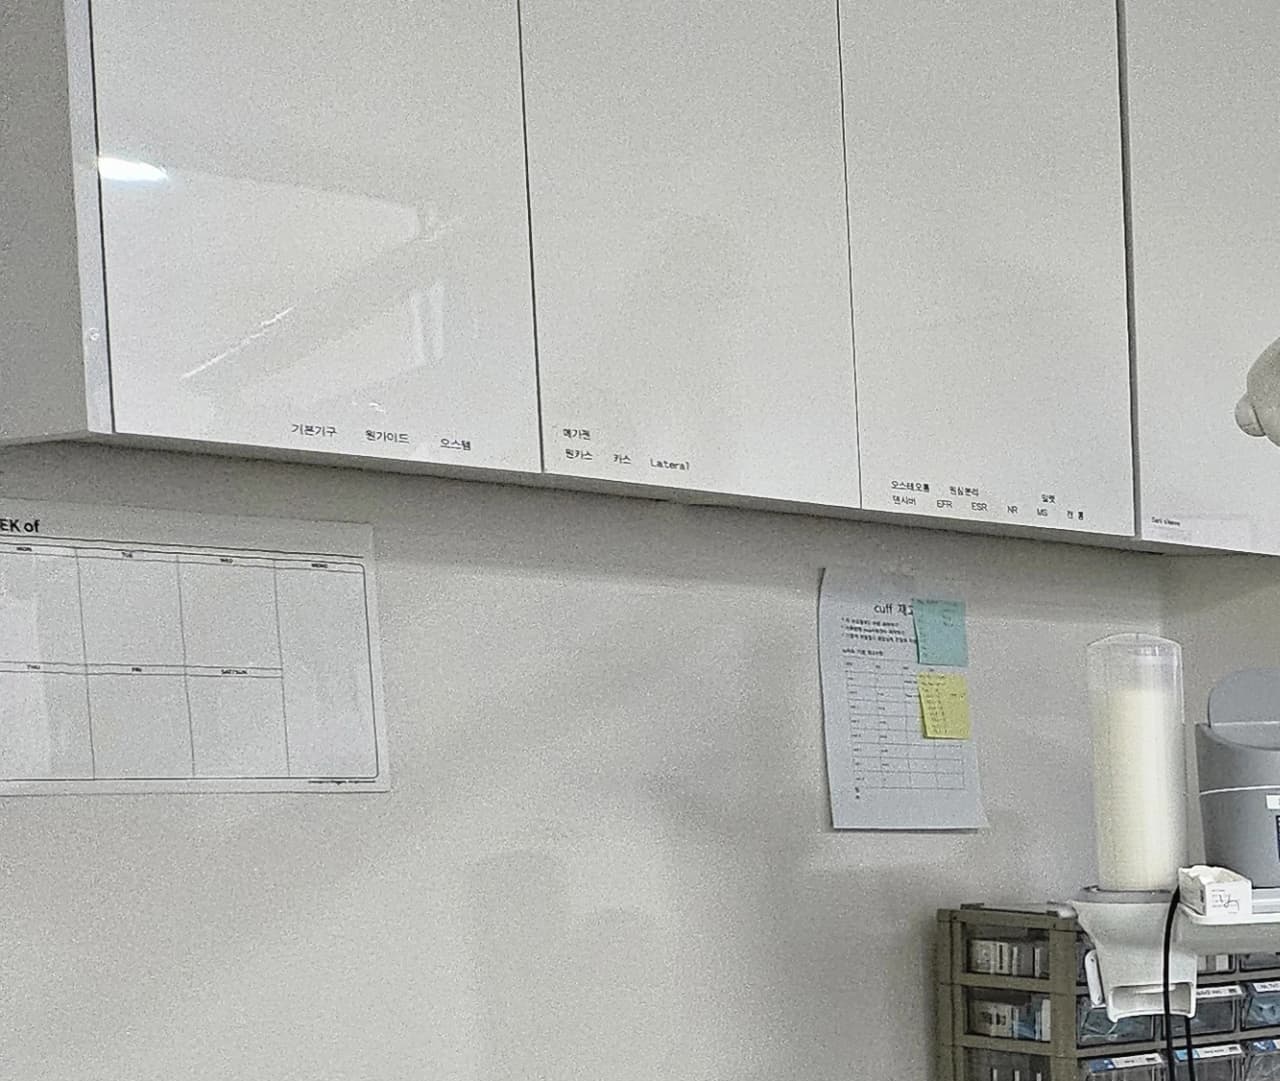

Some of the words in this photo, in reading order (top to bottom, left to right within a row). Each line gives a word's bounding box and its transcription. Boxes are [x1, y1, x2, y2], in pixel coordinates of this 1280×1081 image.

[291, 423, 337, 438] 기본기구
[365, 429, 409, 444] 원가이드
[440, 438, 472, 451] 오스템
[613, 453, 632, 465] 카스
[650, 458, 690, 471] Lateral
[936, 499, 953, 509] EFR
[971, 501, 988, 511] ESR
[1007, 505, 1018, 514] NR
[0, 519, 21, 533] EK
[24, 519, 40, 533] of
[873, 603, 893, 615] cuff
